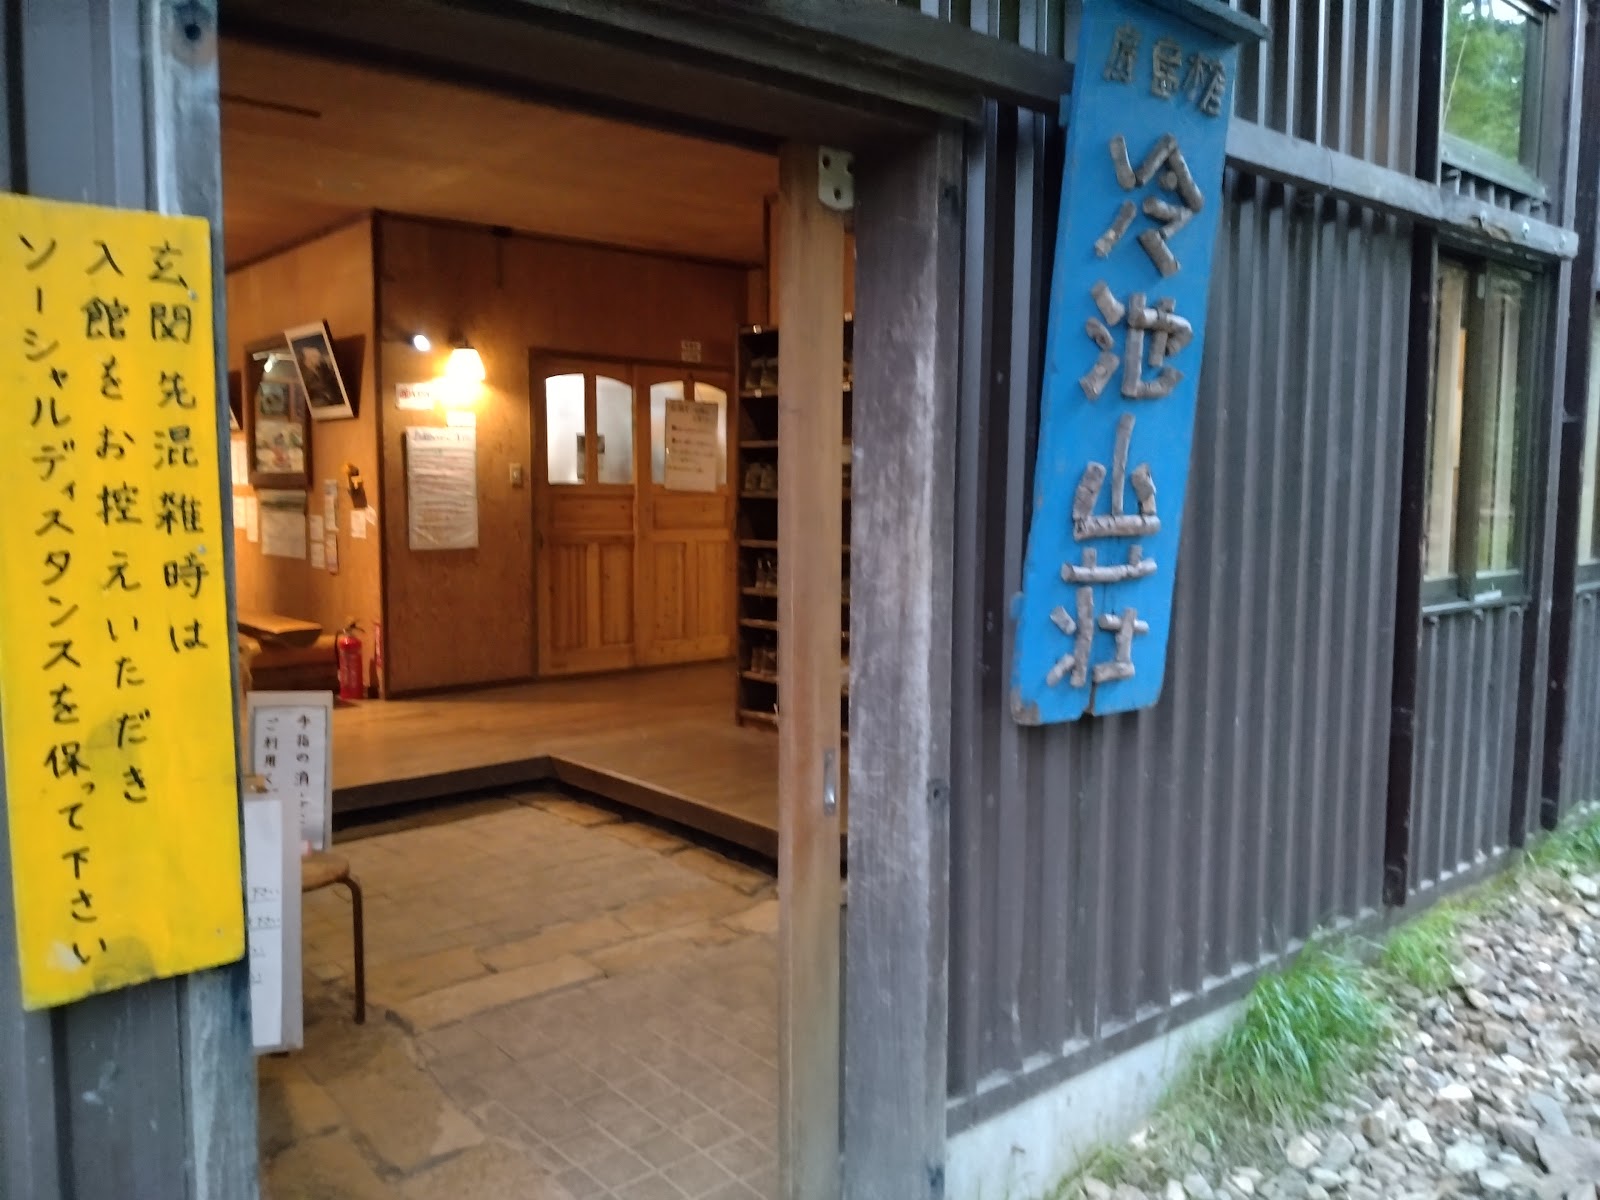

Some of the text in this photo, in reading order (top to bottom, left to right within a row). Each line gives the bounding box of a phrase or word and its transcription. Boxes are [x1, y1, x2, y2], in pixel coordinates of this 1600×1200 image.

[18, 233, 107, 965] ソーシャルディスタンスを保って下さい
[81, 238, 151, 803] 入館をお控えいただき
[147, 239, 209, 653] 玄関先混雑時は
[1046, 132, 1204, 688] 冷池山荘
